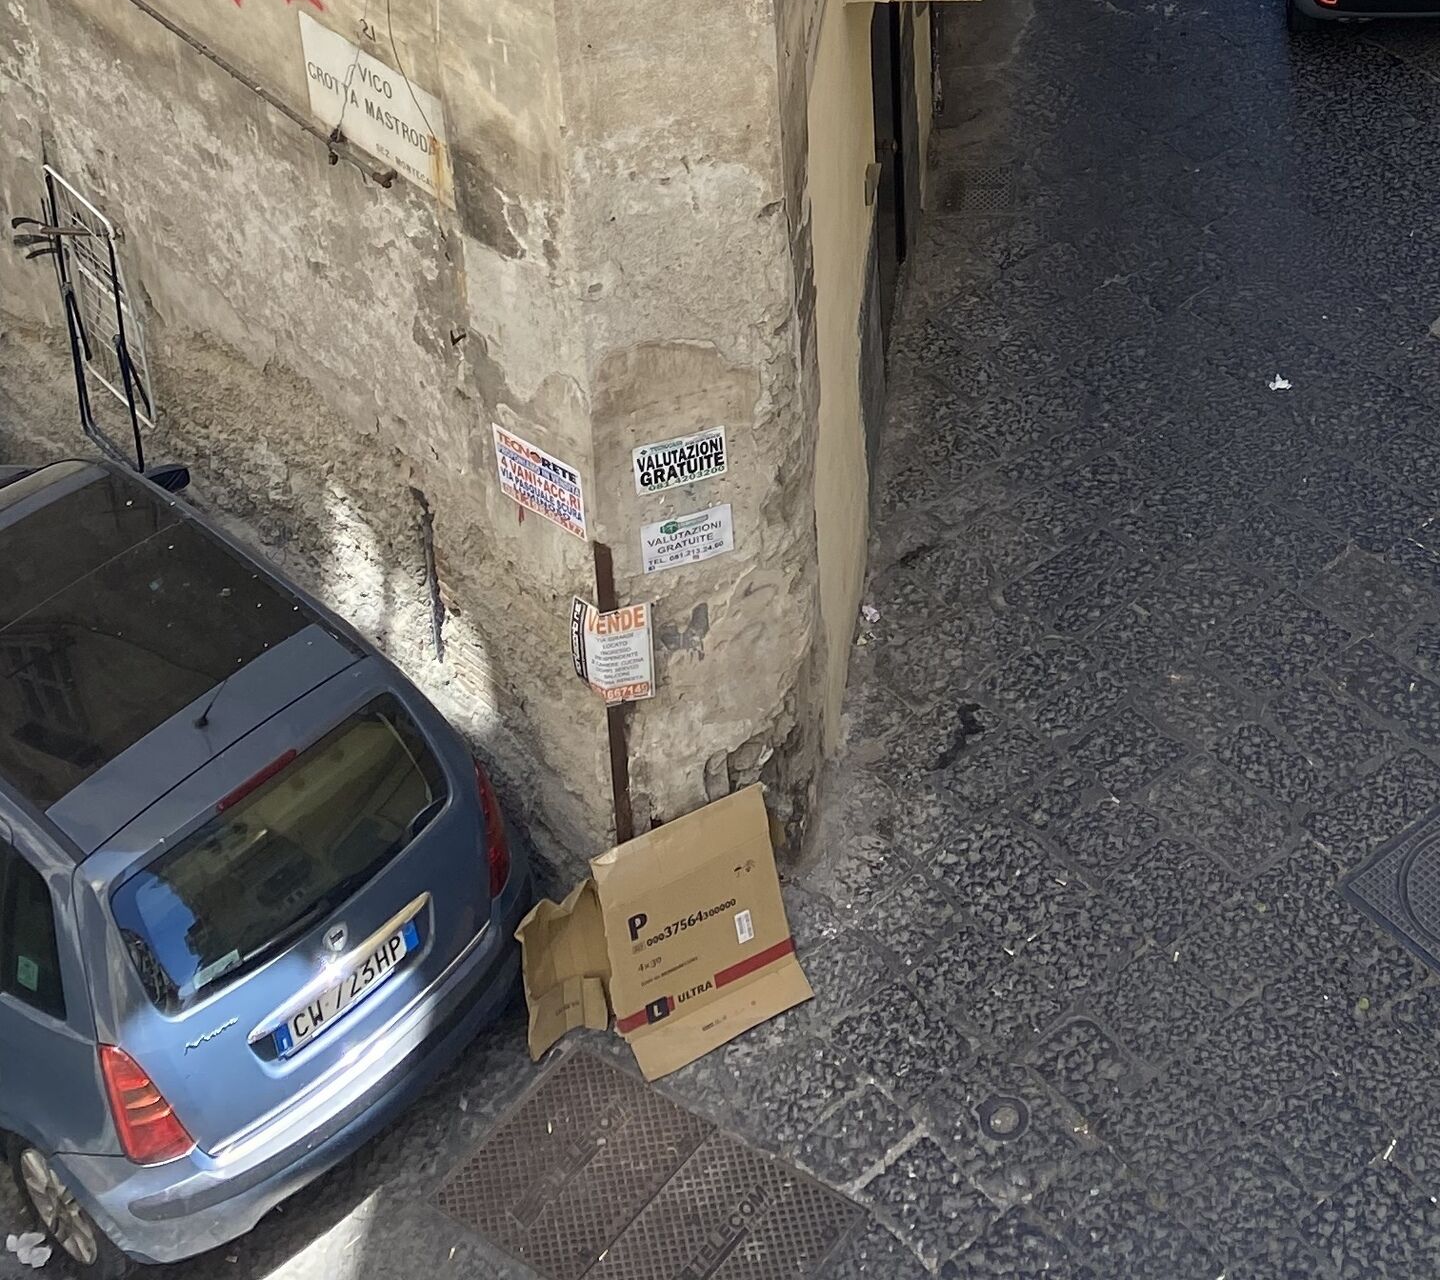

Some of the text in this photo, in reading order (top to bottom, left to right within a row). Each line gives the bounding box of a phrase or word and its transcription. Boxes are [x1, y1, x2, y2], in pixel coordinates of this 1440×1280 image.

[307, 61, 360, 108] GROTTA
[357, 62, 393, 99] VICO
[636, 436, 723, 473] VALUTAZIONI
[640, 451, 725, 487] GRATUITE
[500, 468, 514, 481] VIA
[514, 476, 555, 506] PASQUALE
[647, 520, 722, 548] VALUTAZIONI
[657, 532, 714, 554] GRATUITE
[588, 605, 645, 635] VENDE
[627, 913, 648, 941] P
[677, 980, 713, 1003] ULTRA
[292, 999, 325, 1038] CW
